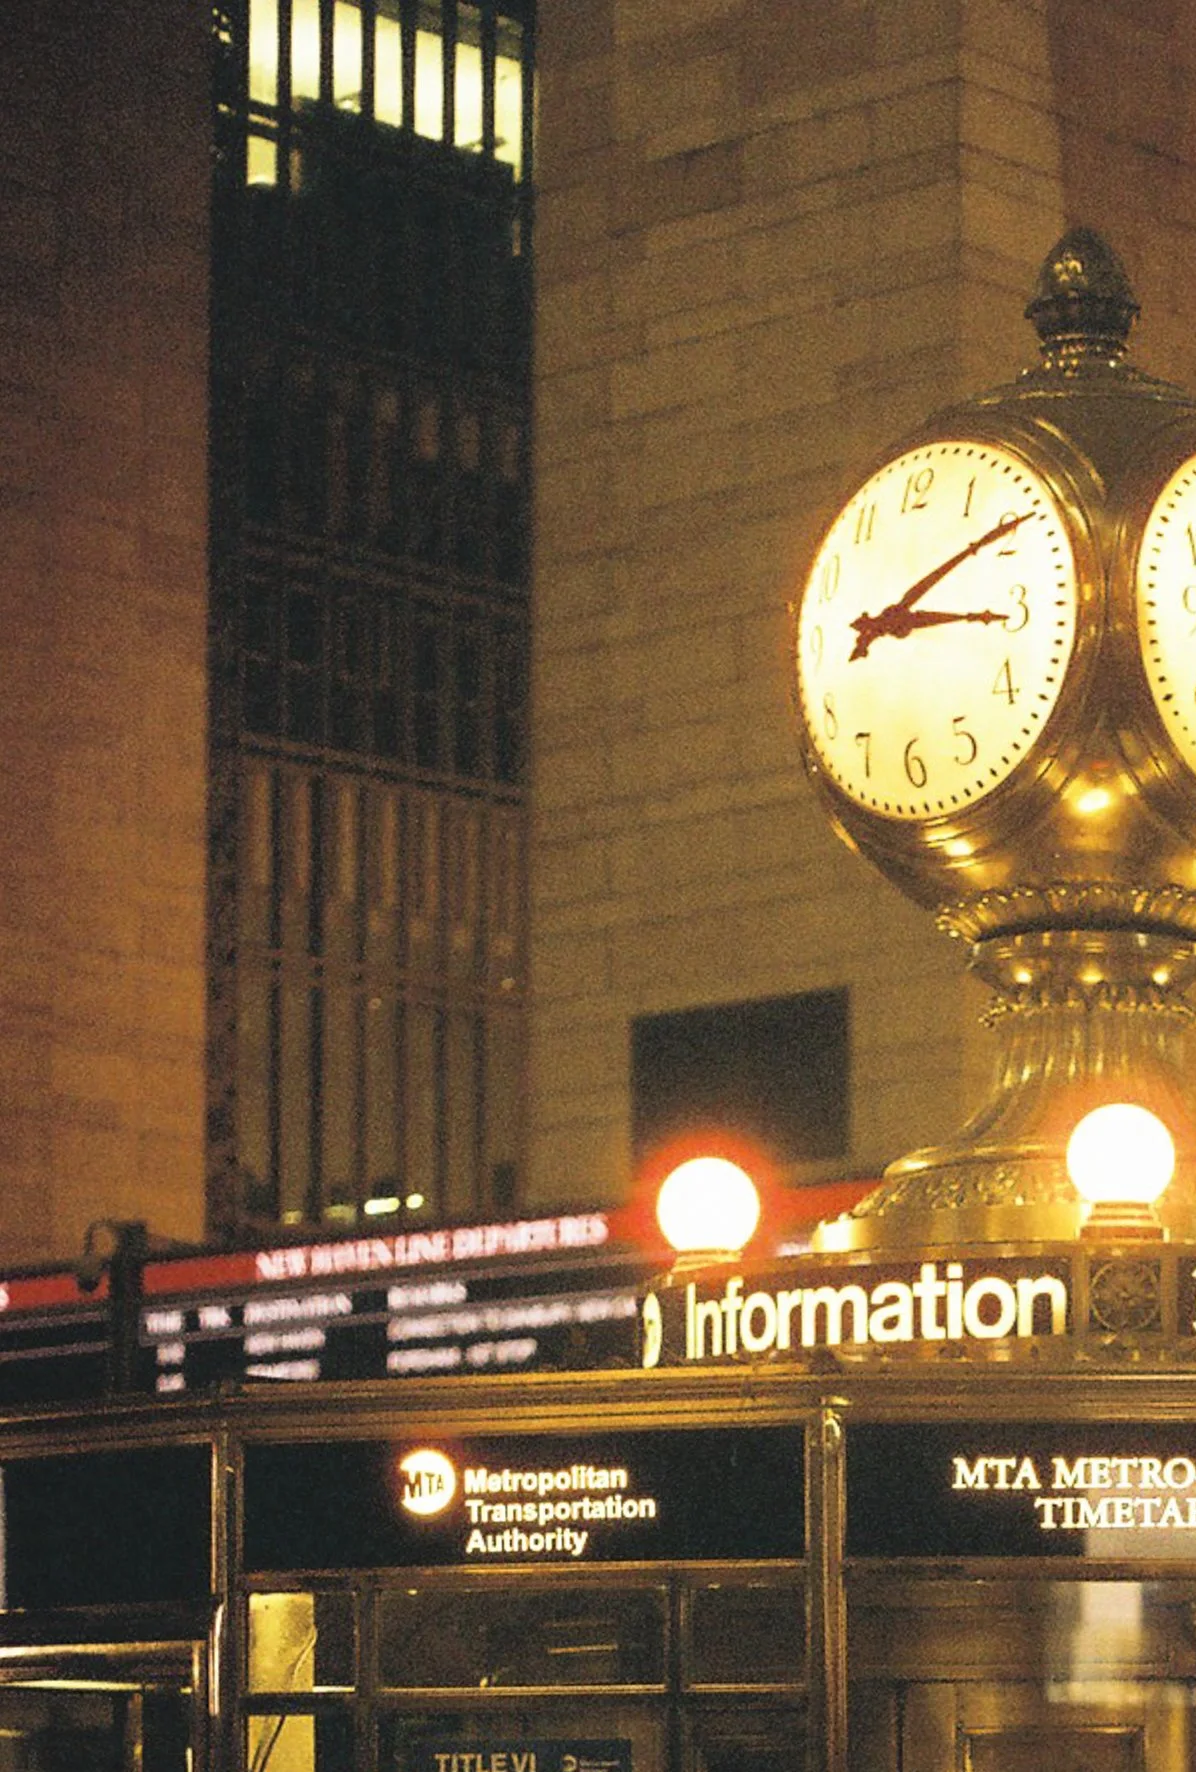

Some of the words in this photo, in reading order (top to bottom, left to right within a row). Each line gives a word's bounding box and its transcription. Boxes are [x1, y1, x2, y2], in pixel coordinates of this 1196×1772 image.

[900, 467, 934, 515] 12
[961, 477, 976, 518] 1
[854, 503, 877, 545] 11
[998, 511, 1019, 556] 2
[818, 552, 840, 605] 10
[1005, 583, 1029, 633] 3
[809, 626, 824, 676] 9
[992, 659, 1020, 705] 4
[822, 691, 839, 740] 8
[855, 731, 872, 779] 7
[904, 736, 929, 788] 6
[952, 715, 978, 766] 5
[684, 1261, 1068, 1360] Information
[464, 1465, 628, 1496] Metropolitan
[952, 1457, 1041, 1489] MTA
[465, 1495, 657, 1526] Transportation
[465, 1526, 589, 1556] Authority
